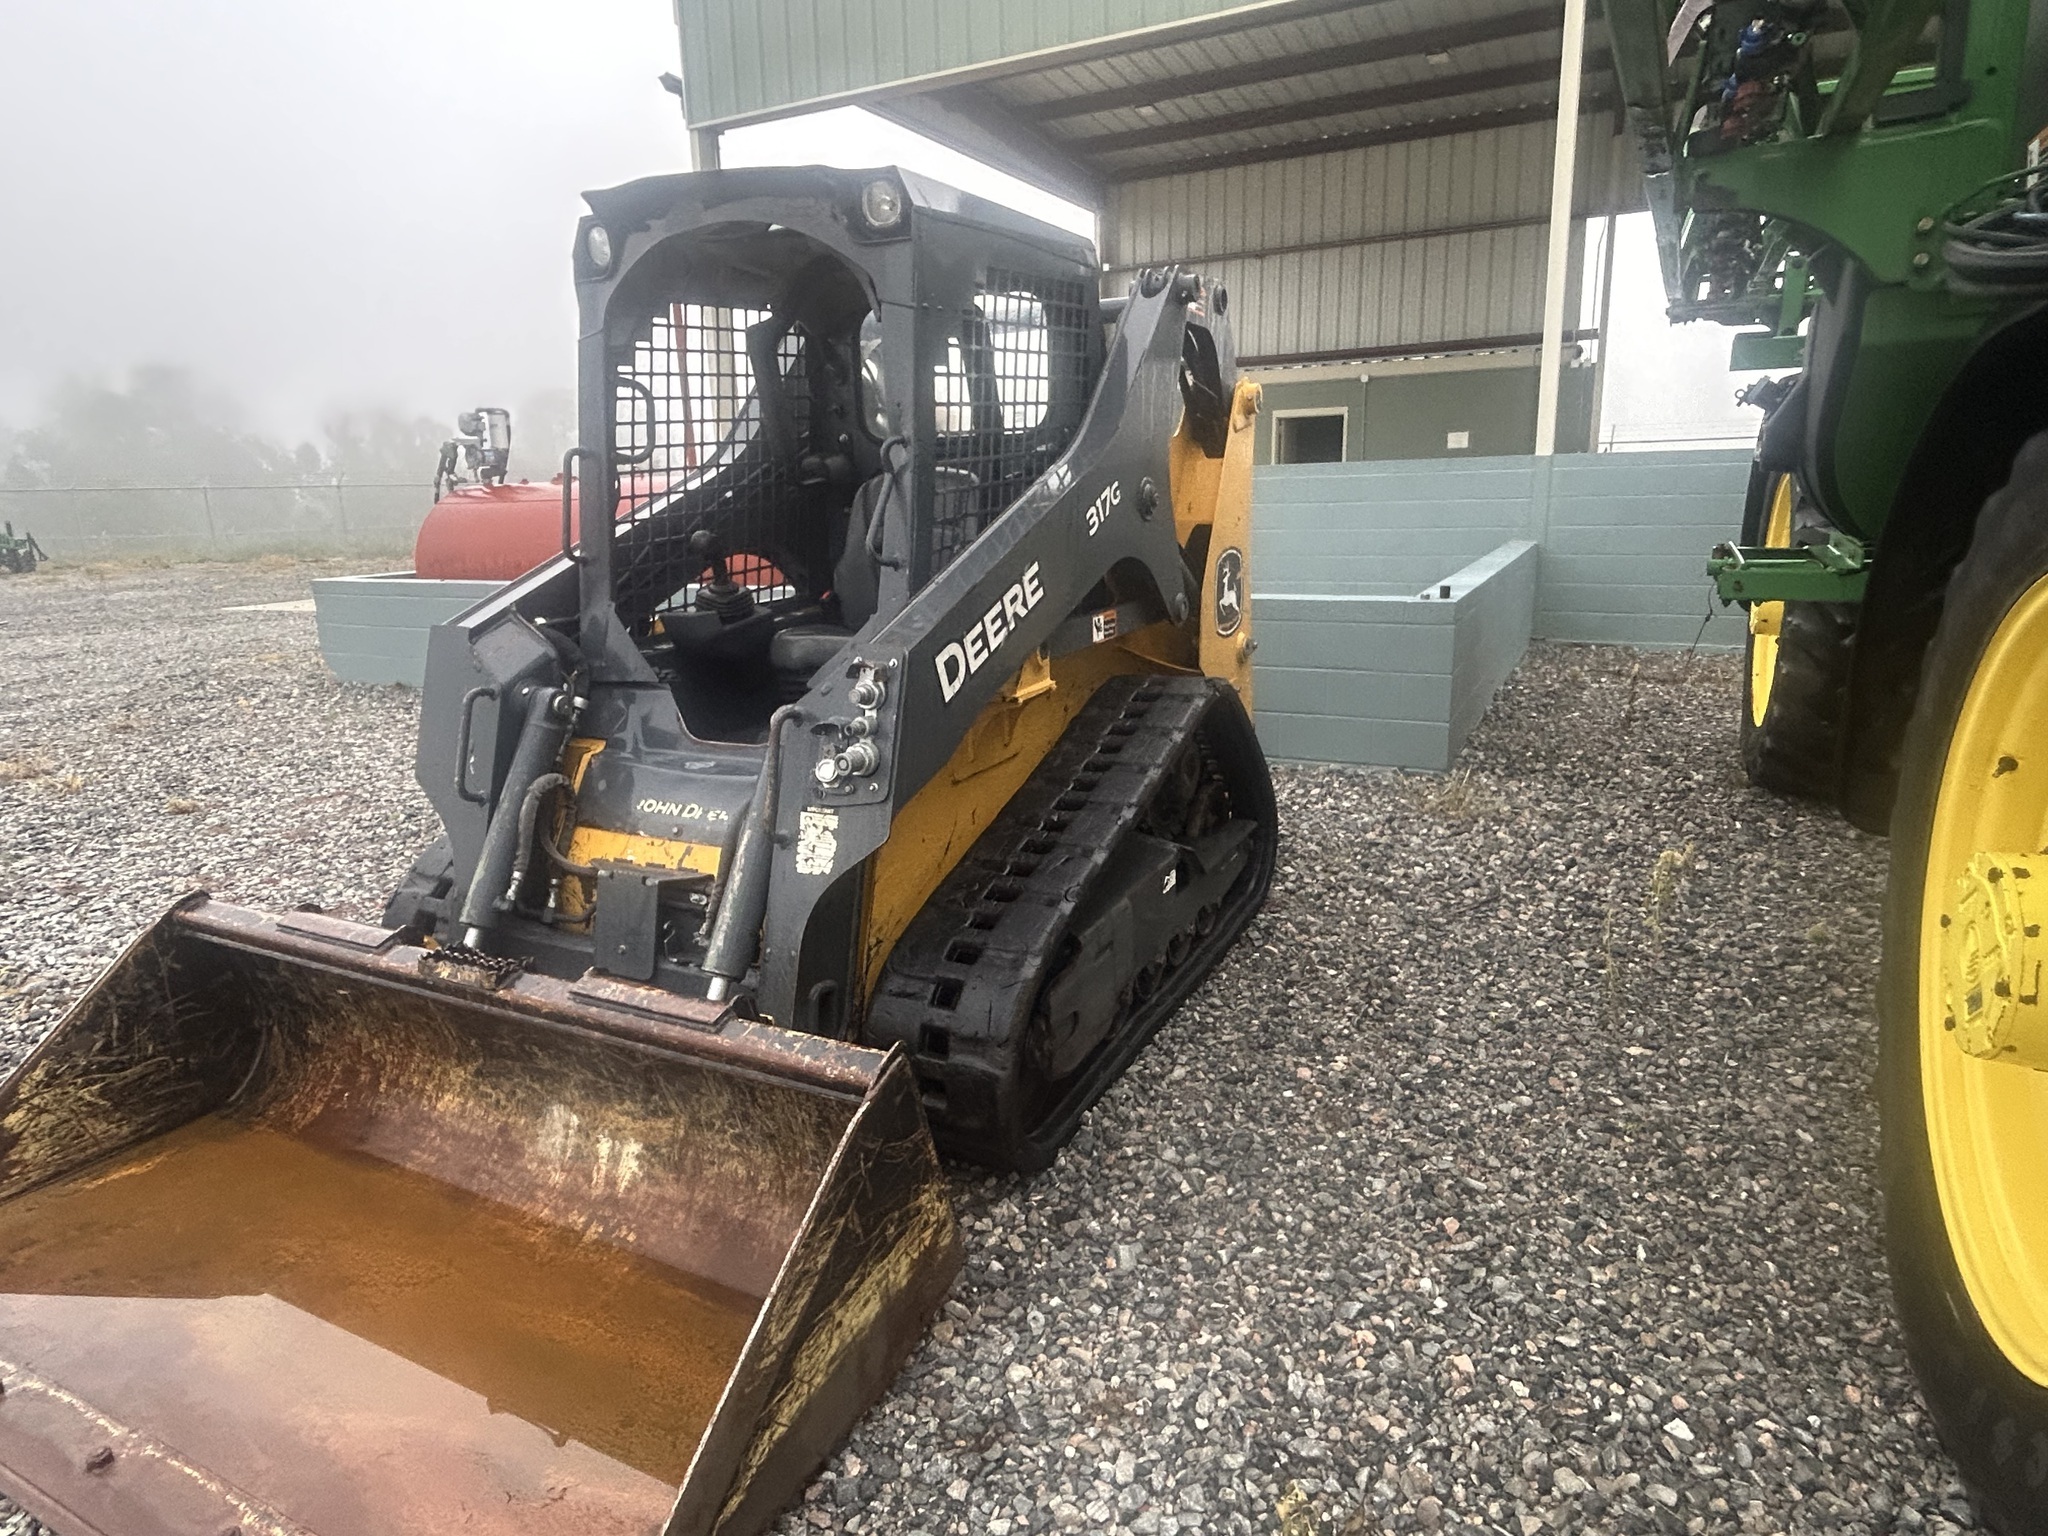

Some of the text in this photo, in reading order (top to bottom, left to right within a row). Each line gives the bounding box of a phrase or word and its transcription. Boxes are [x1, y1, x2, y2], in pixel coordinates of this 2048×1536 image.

[1086, 481, 1121, 536] 317G
[934, 561, 1044, 703] DEERE
[636, 799, 682, 816] JOHN
